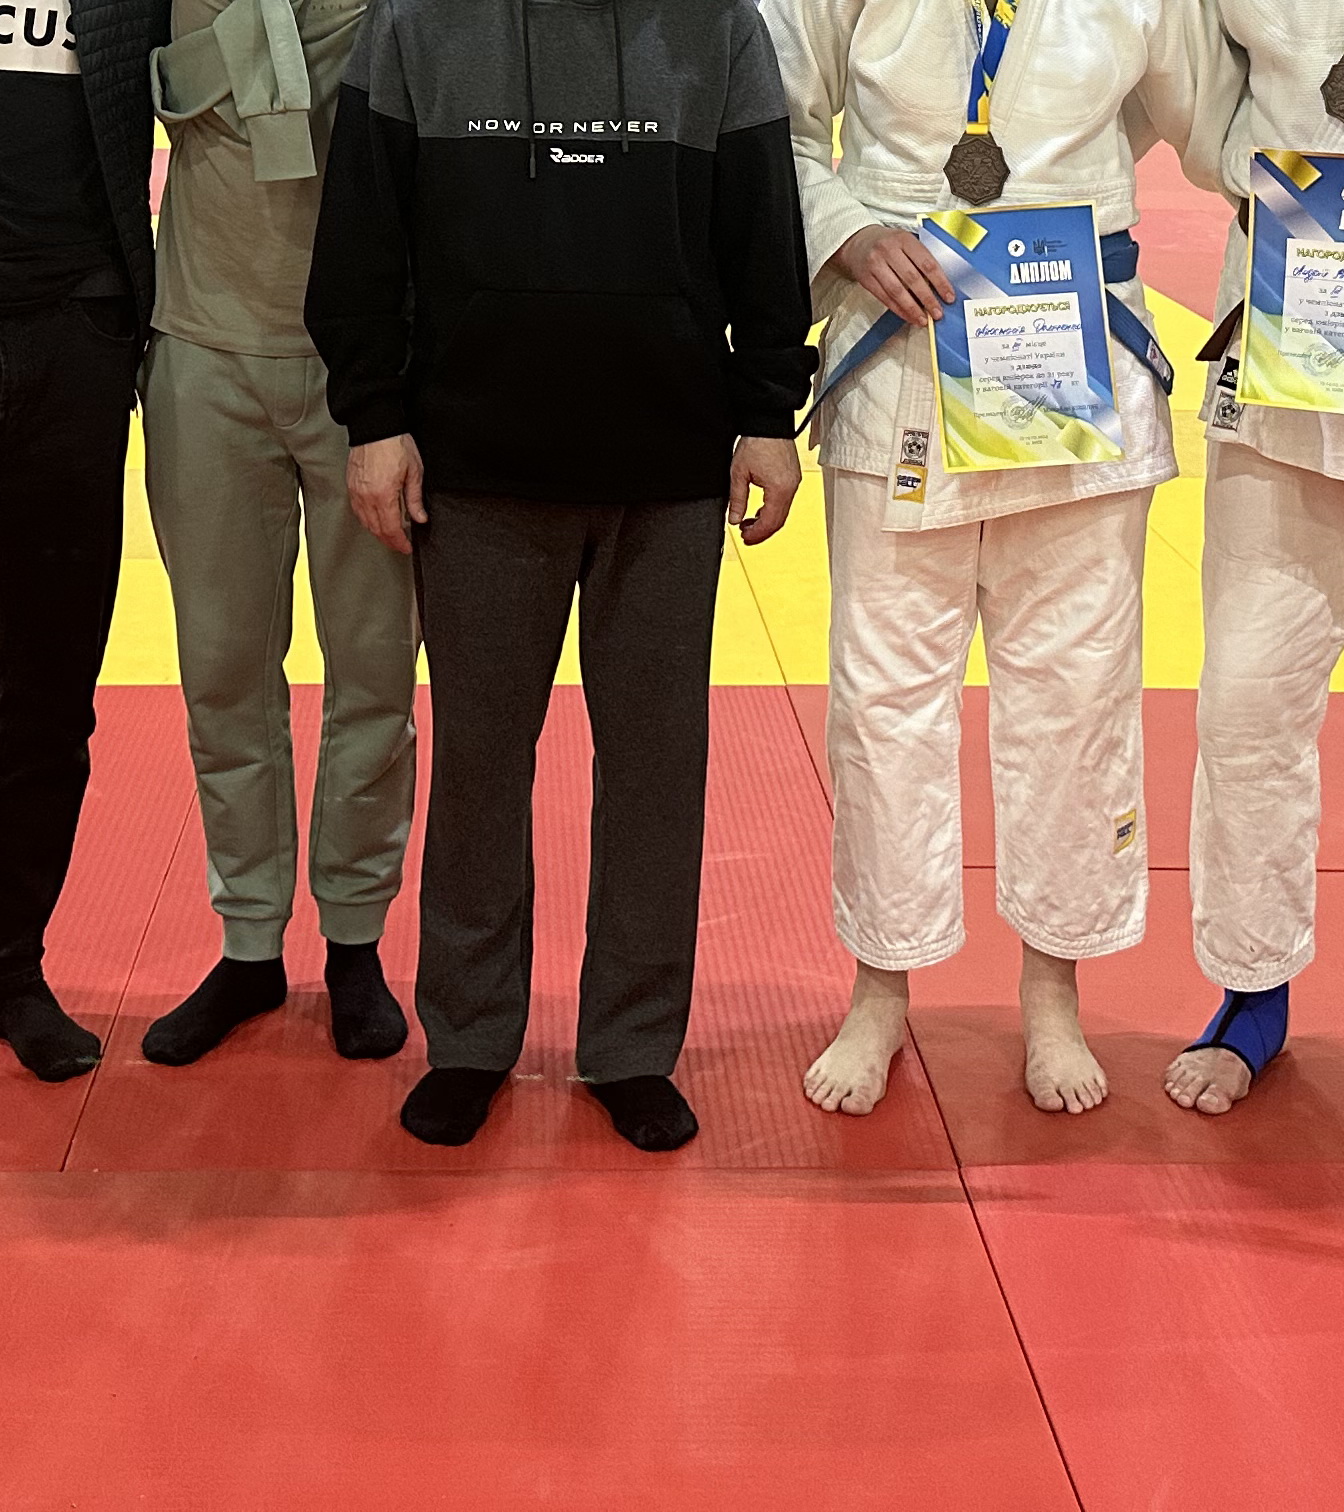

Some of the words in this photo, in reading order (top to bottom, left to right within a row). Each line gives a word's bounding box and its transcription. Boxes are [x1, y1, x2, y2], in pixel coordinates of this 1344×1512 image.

[468, 119, 522, 132] NOW
[533, 122, 564, 134] OR
[573, 120, 659, 133] NEVER
[1009, 259, 1073, 284] ДИПЛОМ
